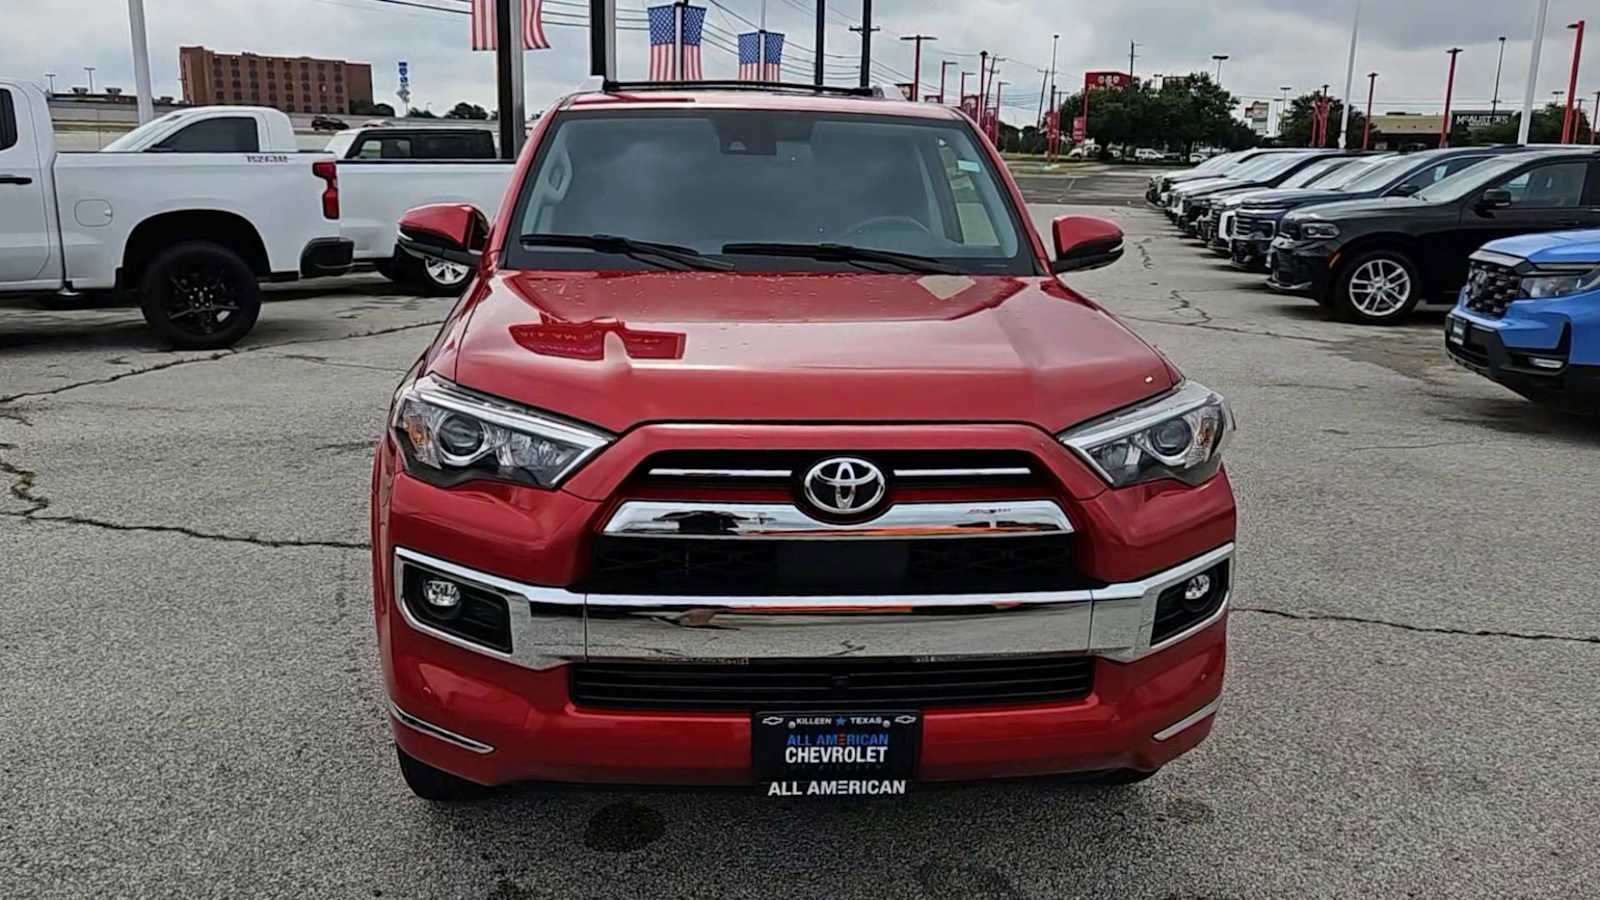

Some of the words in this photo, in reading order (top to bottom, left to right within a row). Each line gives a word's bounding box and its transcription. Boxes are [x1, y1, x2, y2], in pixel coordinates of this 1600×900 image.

[796, 717, 832, 725] KILLEEN
[850, 716, 882, 724] TEXAS
[786, 734, 812, 746] ALL
[816, 734, 889, 746] AMERICAN
[785, 746, 888, 763] CHEVROLET
[768, 781, 803, 796] ALL
[807, 780, 906, 795] AMERICAN
